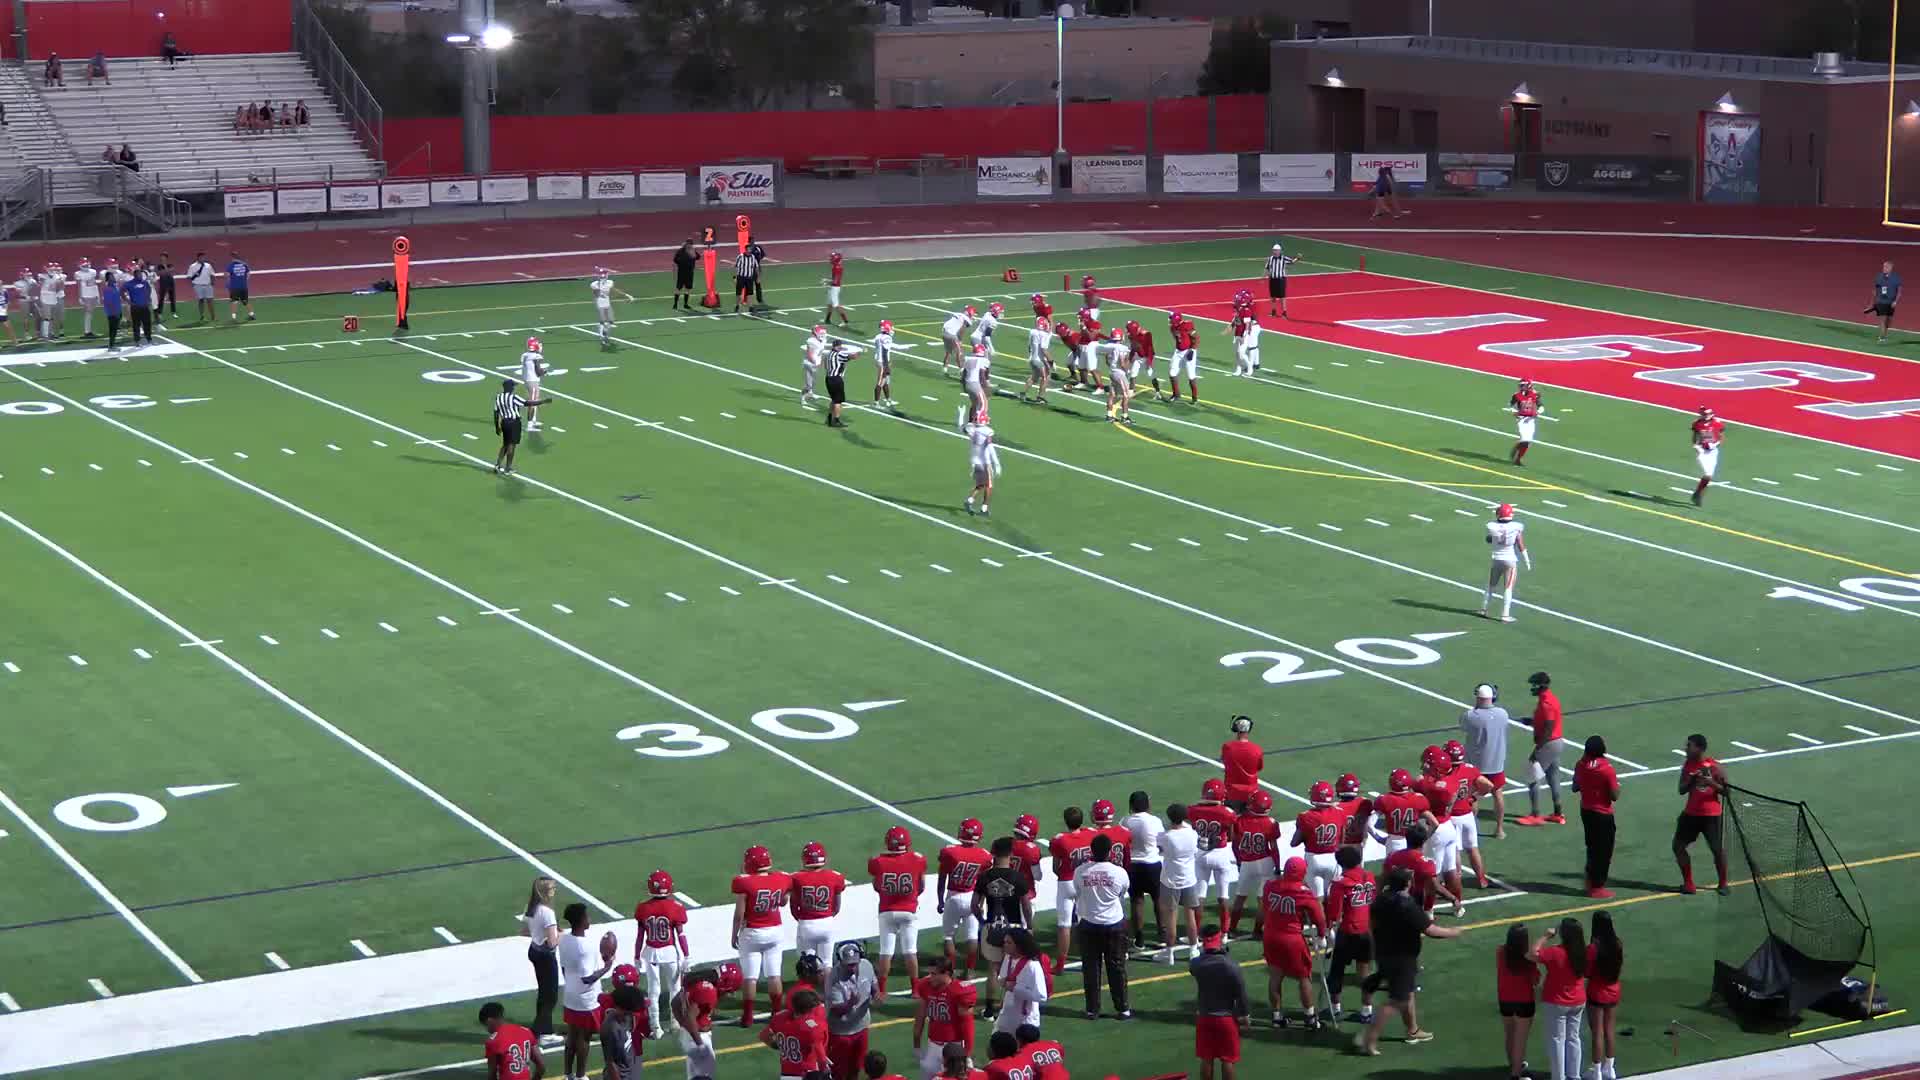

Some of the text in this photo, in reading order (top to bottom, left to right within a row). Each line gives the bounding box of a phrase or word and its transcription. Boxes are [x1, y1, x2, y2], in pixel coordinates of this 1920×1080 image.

[1085, 160, 1118, 168] LEADING
[1357, 159, 1420, 170] HIRSCHI
[1592, 169, 1633, 181] AGGIES
[736, 172, 773, 190] Elite
[727, 189, 764, 198] PAINTING
[704, 227, 714, 242] 2
[344, 317, 358, 330] 20
[1219, 637, 1441, 685] 20
[615, 707, 860, 757] 30
[1391, 807, 1415, 833] 14
[1239, 831, 1266, 854] 48
[1314, 823, 1338, 846] 12
[881, 872, 914, 896] 56
[951, 861, 981, 887] 47
[754, 889, 783, 913] 51
[801, 885, 830, 912] 52
[1267, 892, 1296, 914] 70
